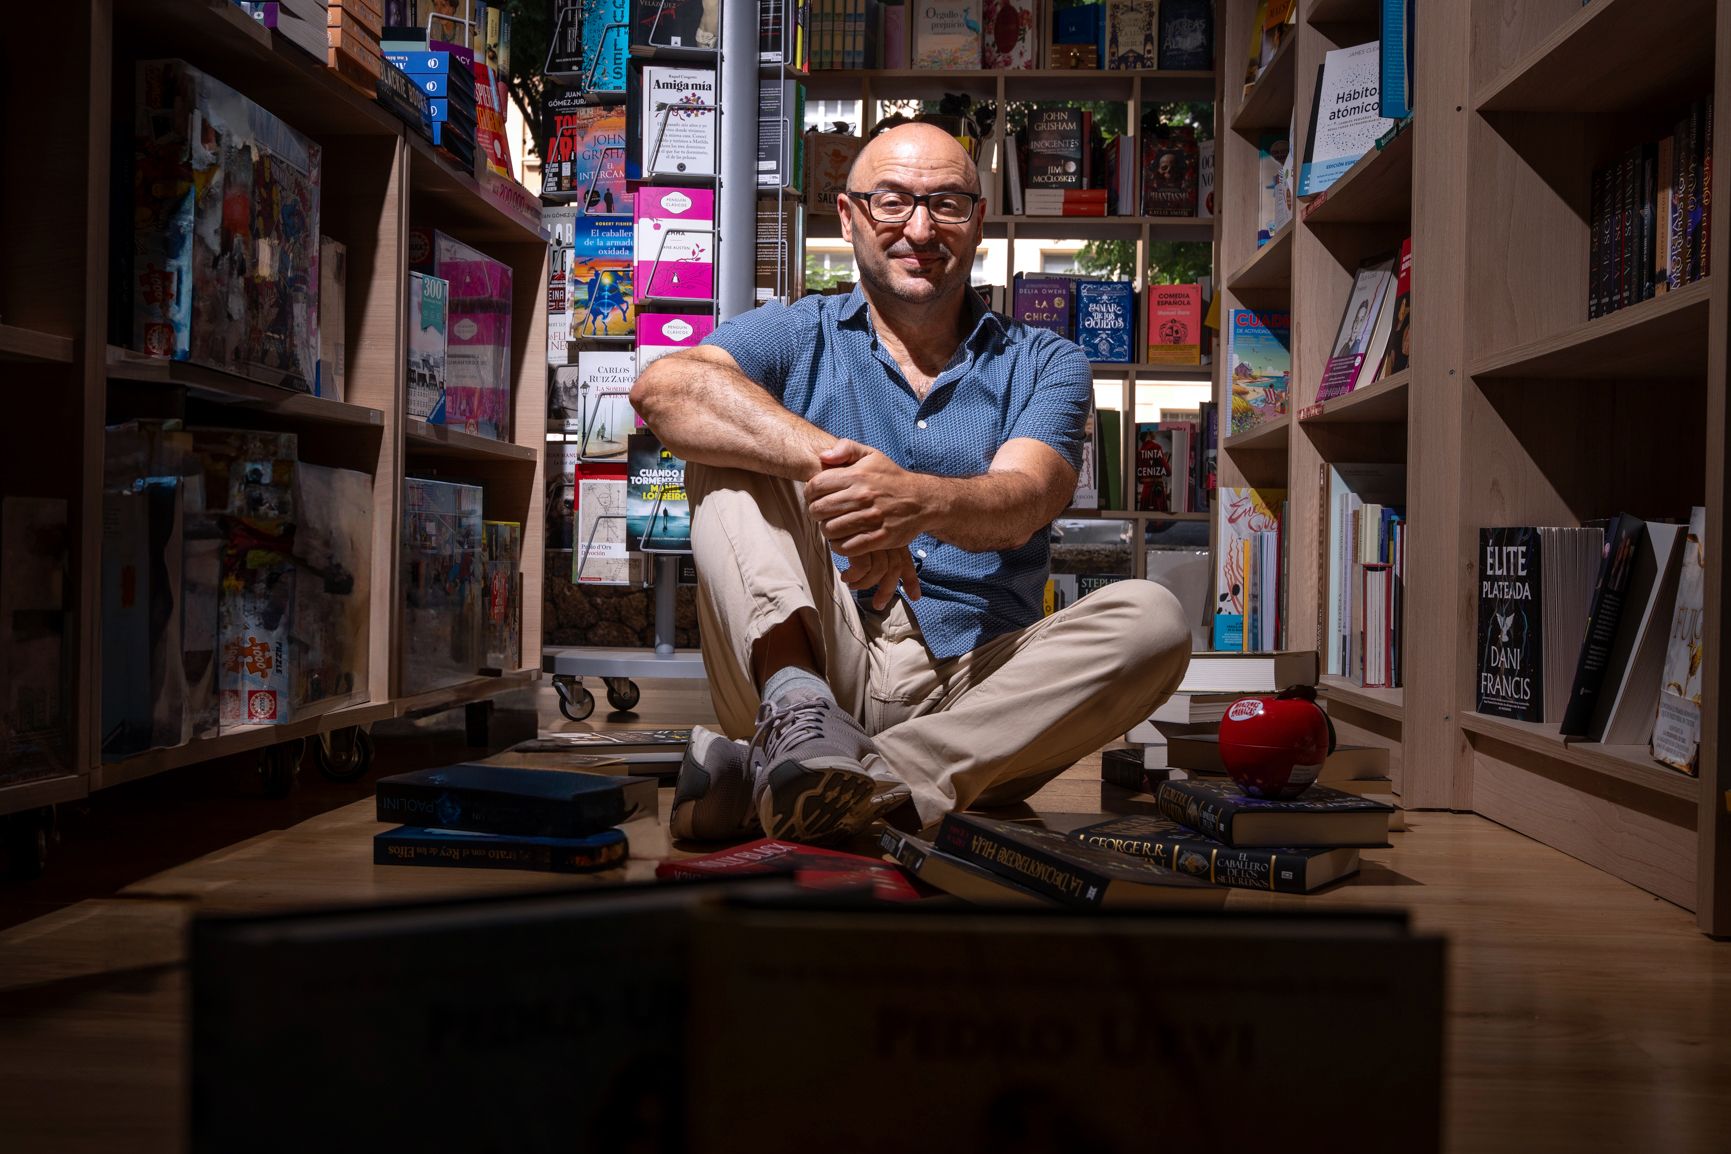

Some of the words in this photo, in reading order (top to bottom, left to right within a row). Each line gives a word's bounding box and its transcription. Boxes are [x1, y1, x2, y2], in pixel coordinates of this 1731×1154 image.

[926, 8, 959, 19] Orgullo
[931, 21, 965, 32] prejuicio
[653, 79, 689, 92] Amiga
[691, 80, 712, 91] mía
[1335, 86, 1380, 104] Hábito
[1043, 112, 1068, 121] JOHN
[1034, 122, 1077, 131] GRISHAM
[593, 134, 626, 147] JOHN
[1031, 139, 1080, 149] INOCENTES
[580, 170, 625, 180] INTRCA
[1048, 165, 1061, 175] JIM
[591, 229, 599, 237] El
[584, 238, 595, 246] de
[597, 238, 604, 246] la
[598, 247, 630, 256] oxidada
[424, 277, 442, 299] 300
[1035, 300, 1048, 308] LA
[1024, 312, 1059, 321] CHICA
[597, 366, 630, 374] CARLOS
[589, 375, 610, 383] RUIZ
[1141, 449, 1163, 459] TINTA
[640, 469, 680, 477] CUANDO
[1137, 467, 1167, 476] CENIZA
[643, 492, 688, 501] LOREIRO
[1486, 540, 1527, 577] ÉLITE
[1081, 577, 1121, 589] STEPH
[1483, 581, 1532, 600] PLATEADA
[1490, 646, 1520, 670] DANI
[1481, 672, 1531, 700] FRANCIS
[383, 796, 434, 814] PAOLINI
[388, 845, 415, 858] Elfos
[970, 834, 998, 859] HIJA
[440, 845, 460, 859] Rey
[1239, 852, 1248, 861] EL
[1217, 859, 1269, 872] CABALLERO
[1228, 868, 1239, 877] DE
[1241, 869, 1257, 879] LOS
